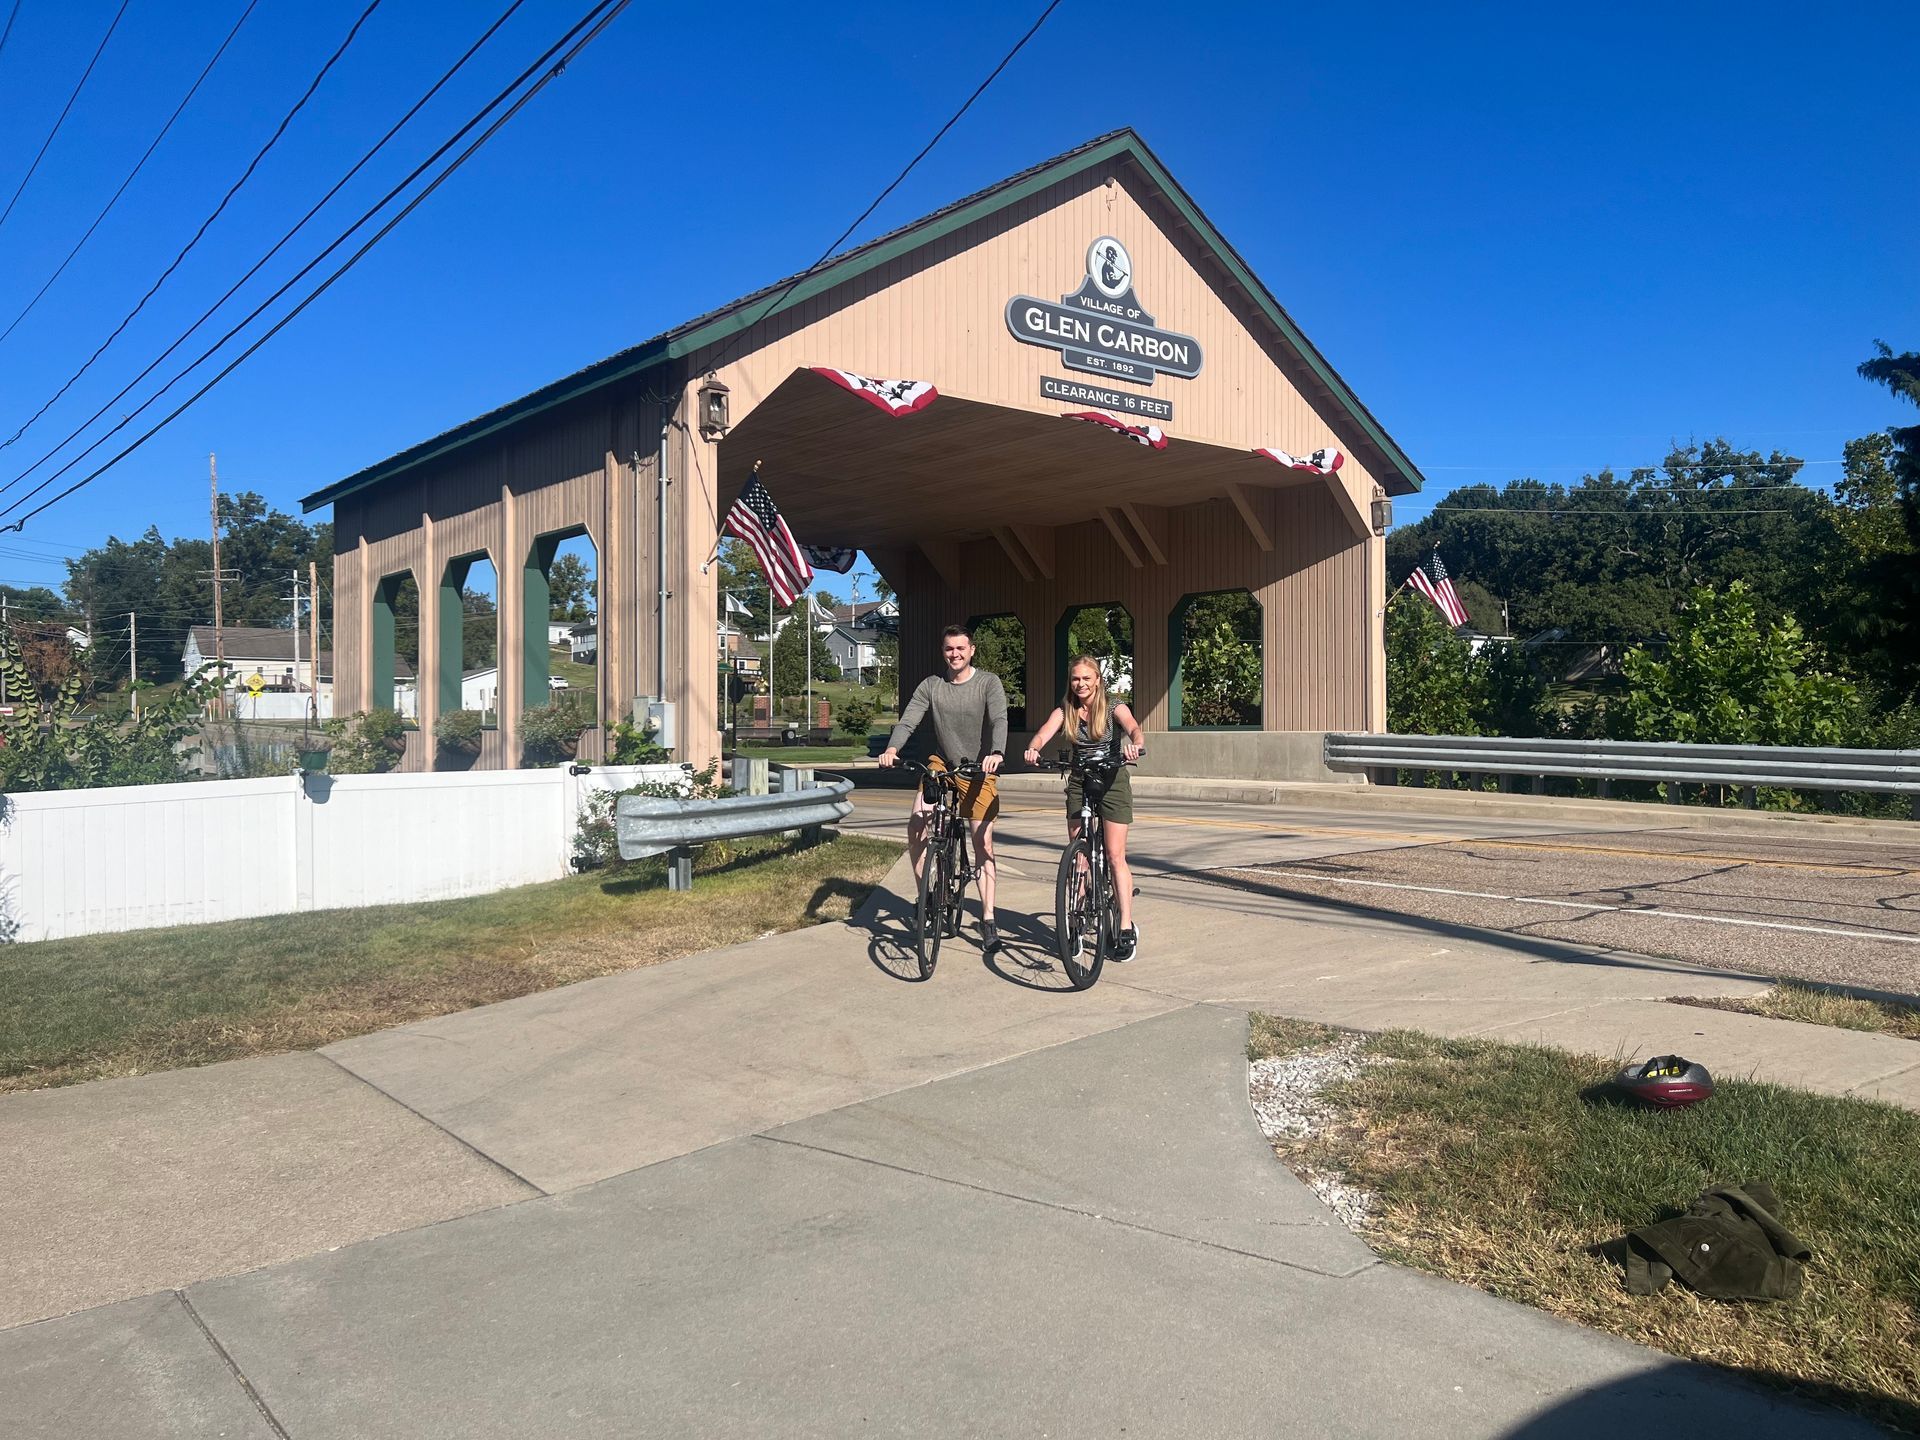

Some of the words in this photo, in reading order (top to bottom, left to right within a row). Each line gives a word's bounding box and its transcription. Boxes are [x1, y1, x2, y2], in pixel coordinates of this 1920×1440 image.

[1080, 296, 1123, 316] VILLAGE
[1127, 308, 1141, 319] OF
[1025, 307, 1090, 342] GLEN
[1097, 325, 1188, 365] CARBON
[1087, 356, 1107, 368] EST.
[1113, 362, 1134, 374] 1892
[1045, 381, 1119, 406] CLEARANCE
[1124, 397, 1135, 408] 16
[1140, 400, 1169, 415] FEET
